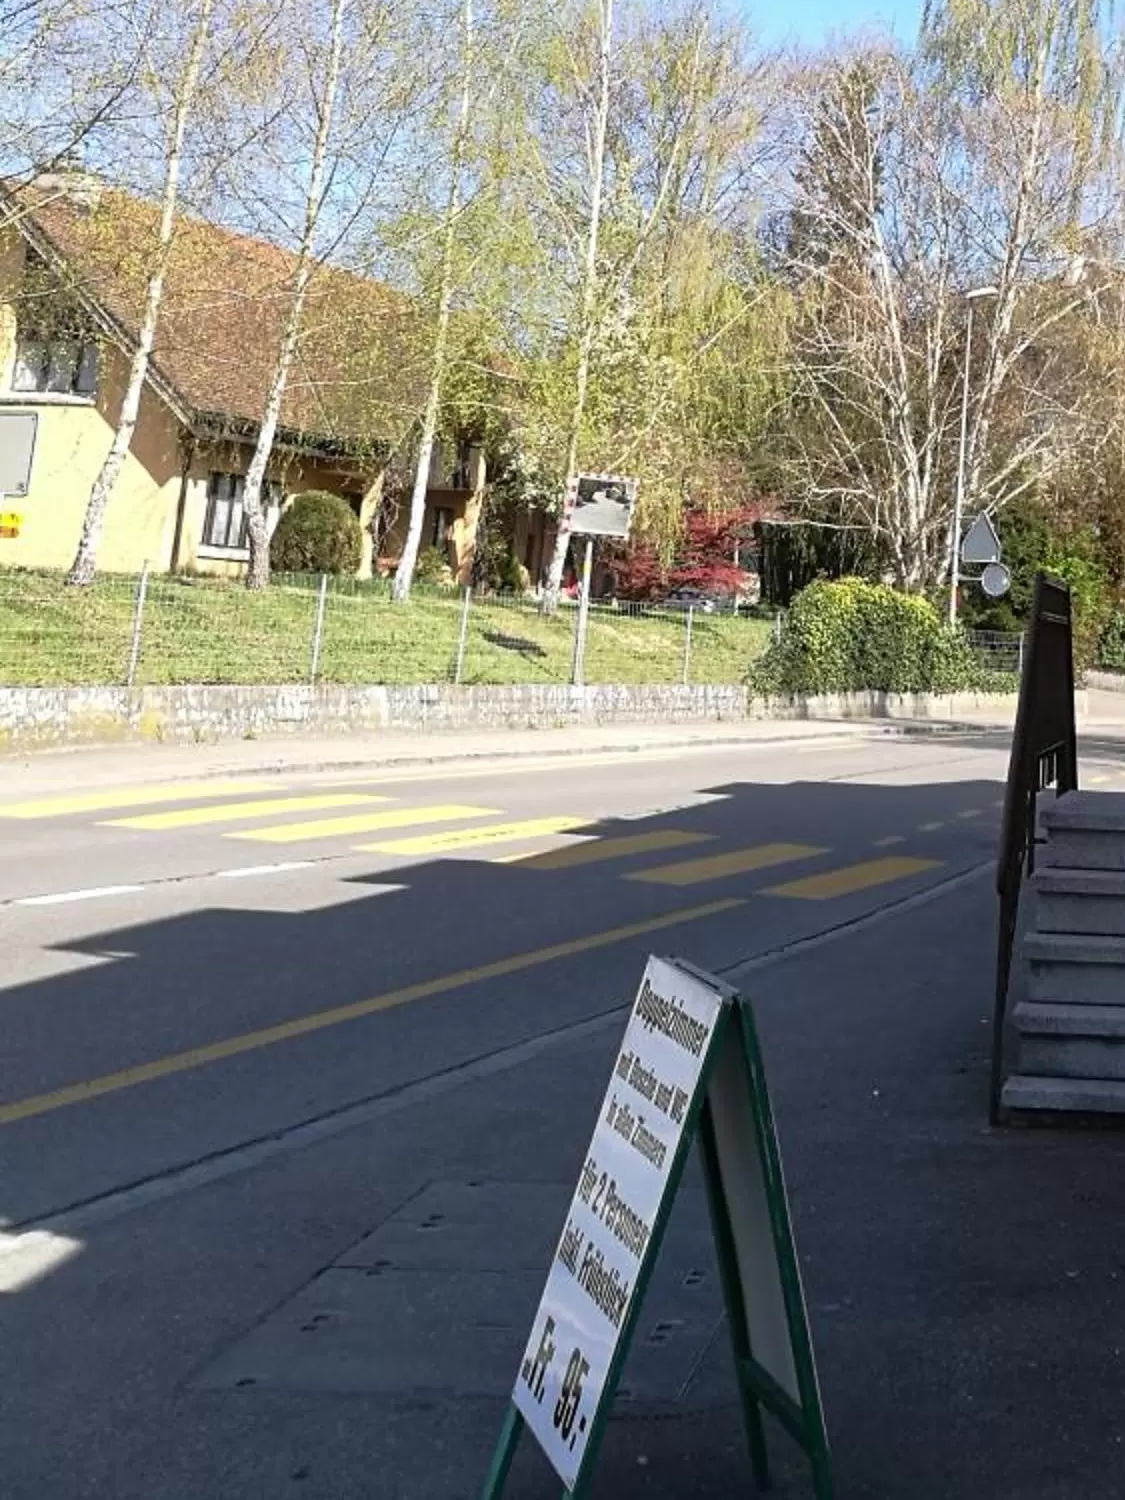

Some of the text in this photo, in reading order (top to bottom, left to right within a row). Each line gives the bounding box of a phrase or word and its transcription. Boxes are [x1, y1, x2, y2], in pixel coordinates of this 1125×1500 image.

[635, 979, 709, 1057] Doppelzimmer
[592, 1171, 607, 1214] 2
[600, 1179, 649, 1258] Personen
[577, 1241, 628, 1328] Frühstück
